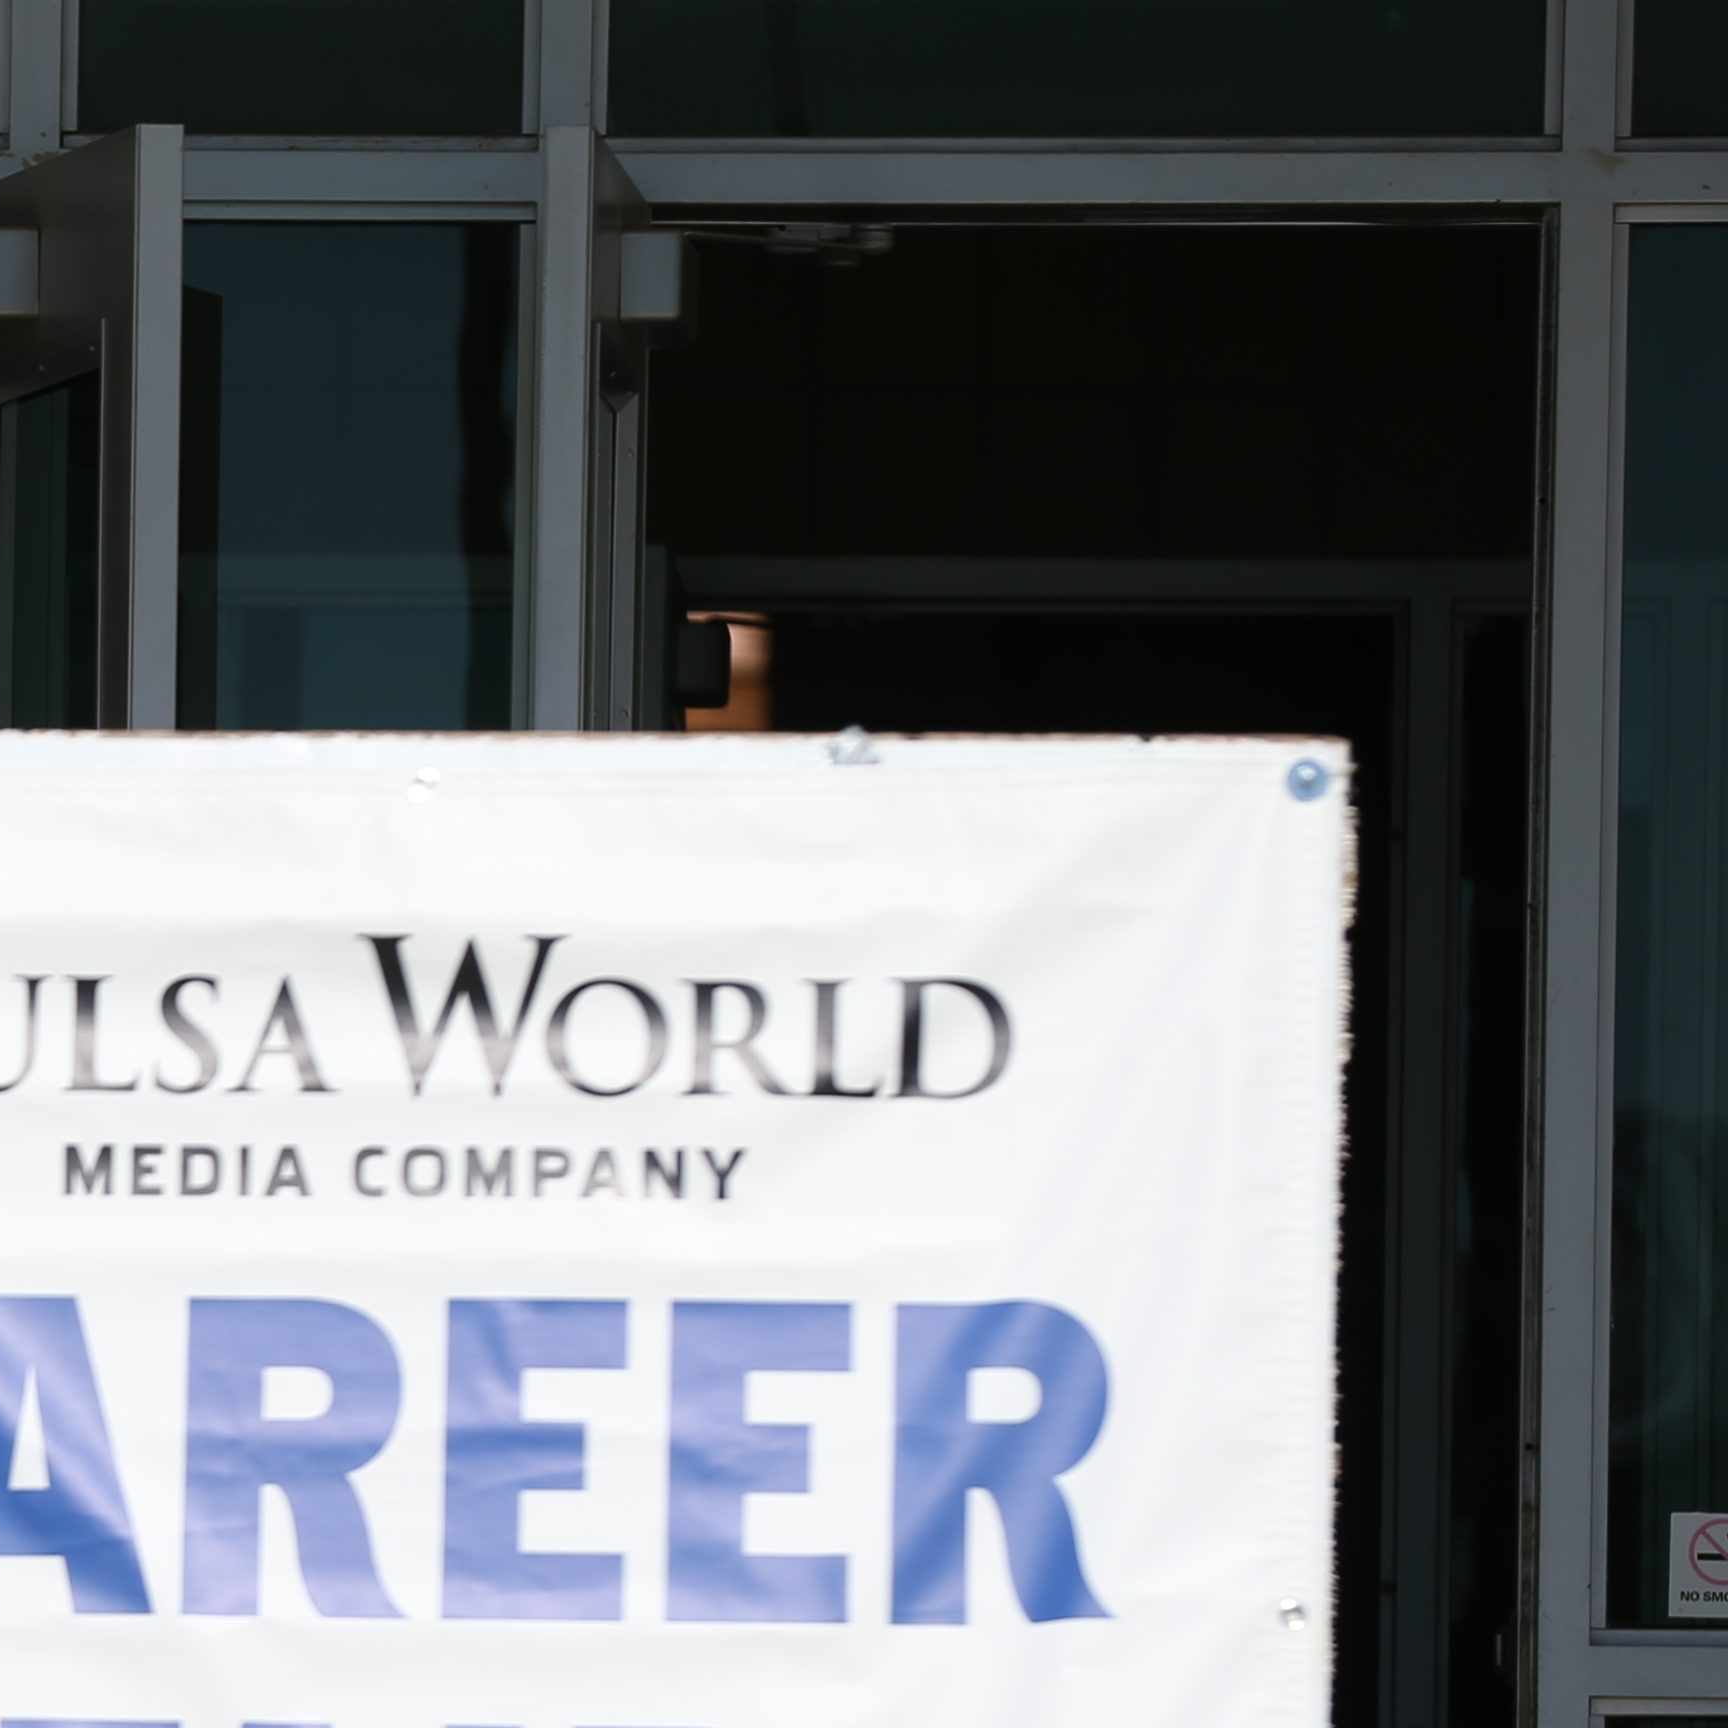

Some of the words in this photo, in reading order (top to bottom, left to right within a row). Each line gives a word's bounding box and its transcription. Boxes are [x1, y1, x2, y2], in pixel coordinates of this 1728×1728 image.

[356, 932, 1014, 1101] WORLD
[63, 1142, 311, 1198] MEDIA
[352, 1145, 747, 1202] COMPANY
[1680, 1590, 1700, 1602] NO
